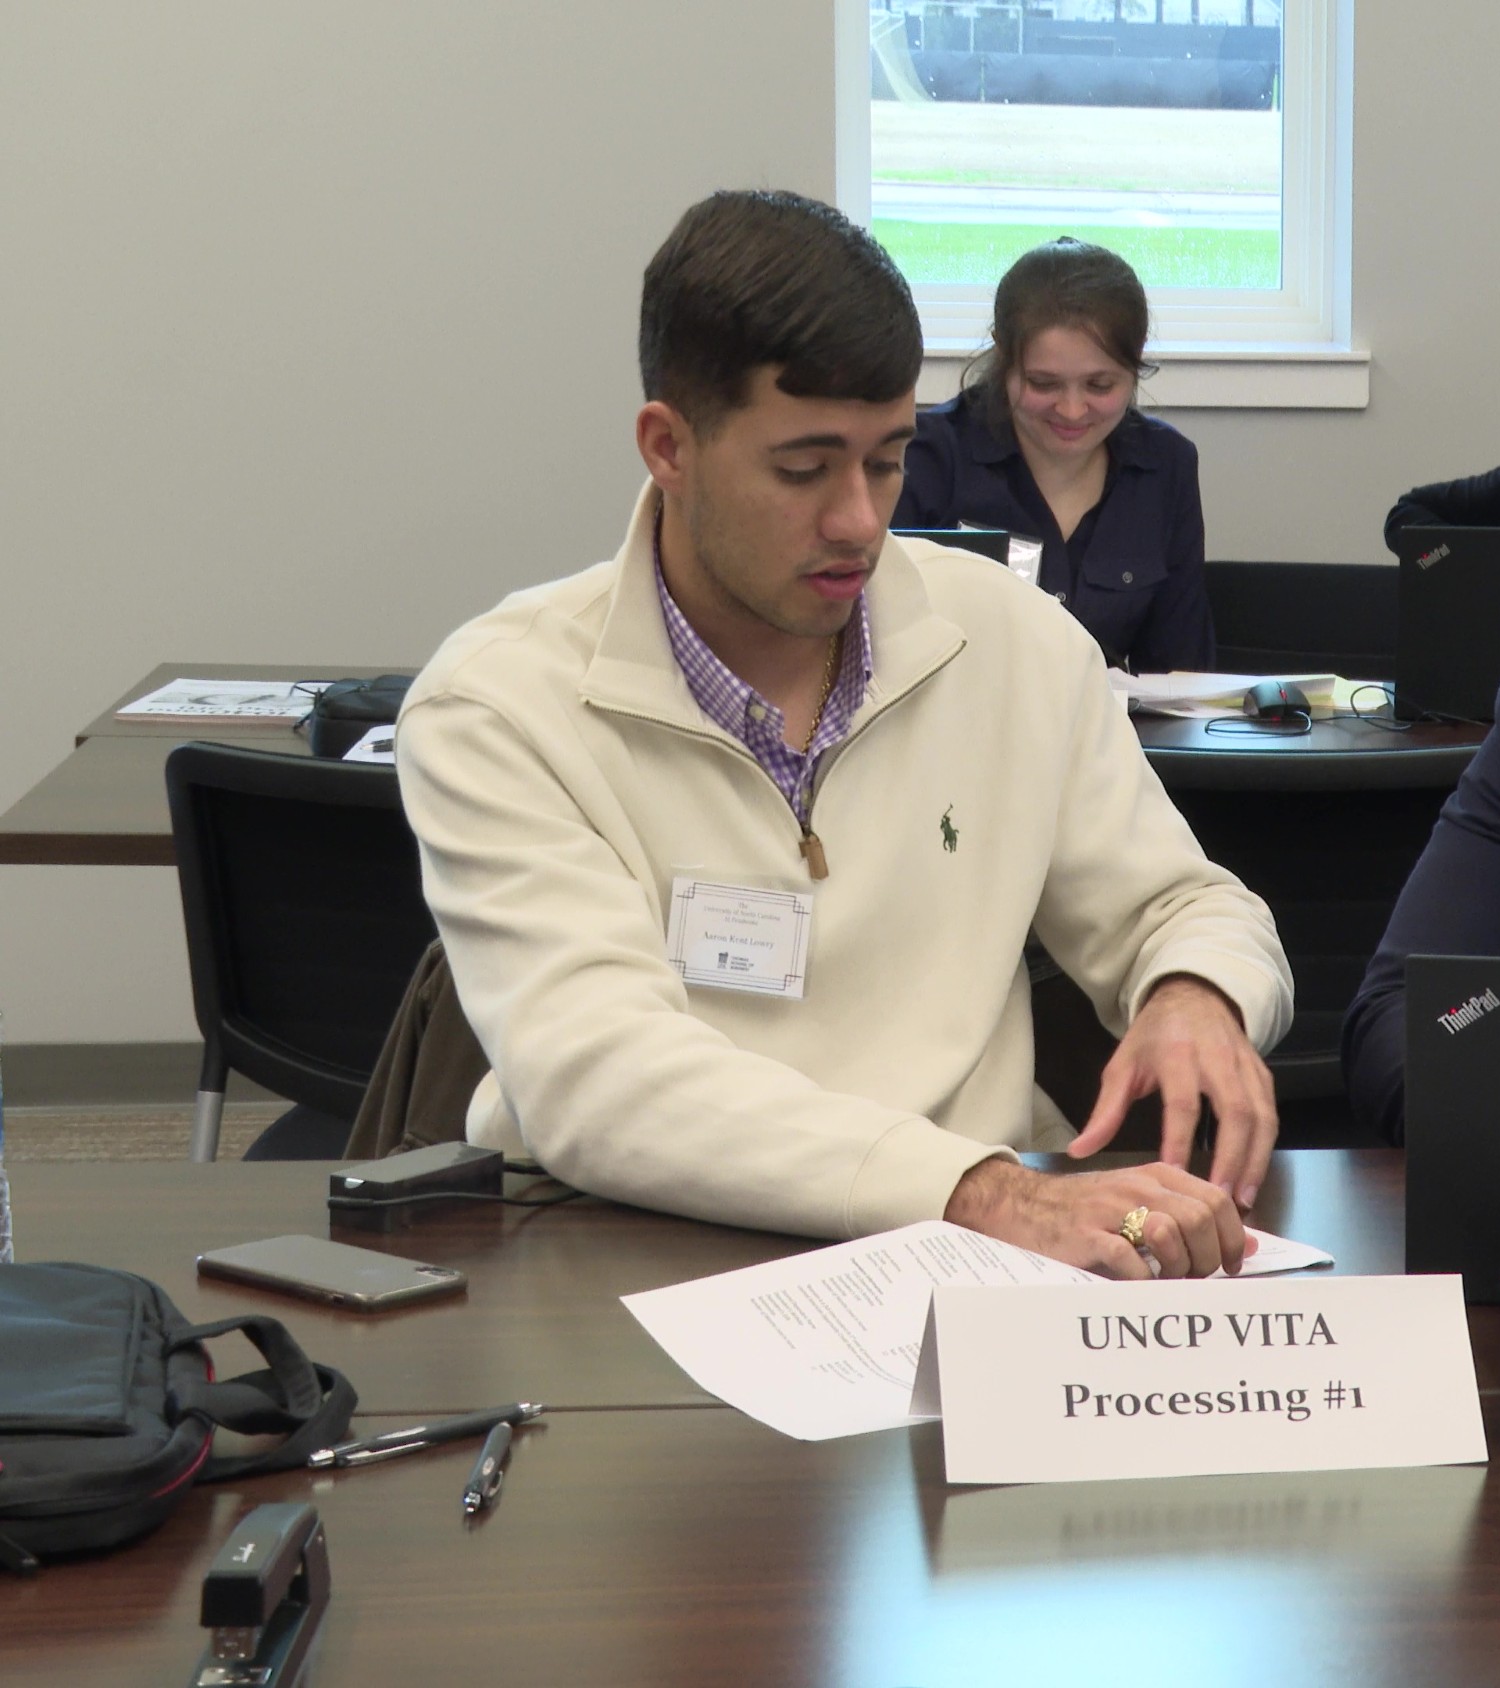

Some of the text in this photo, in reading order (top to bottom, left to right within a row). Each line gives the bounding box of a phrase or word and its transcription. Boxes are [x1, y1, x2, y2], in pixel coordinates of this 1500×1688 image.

[1416, 543, 1451, 570] ThinkPad
[704, 931, 775, 950] Aaron Kent Lowry
[1078, 1312, 1338, 1350] UNCP VITA
[1061, 1379, 1367, 1422] Processing #1
